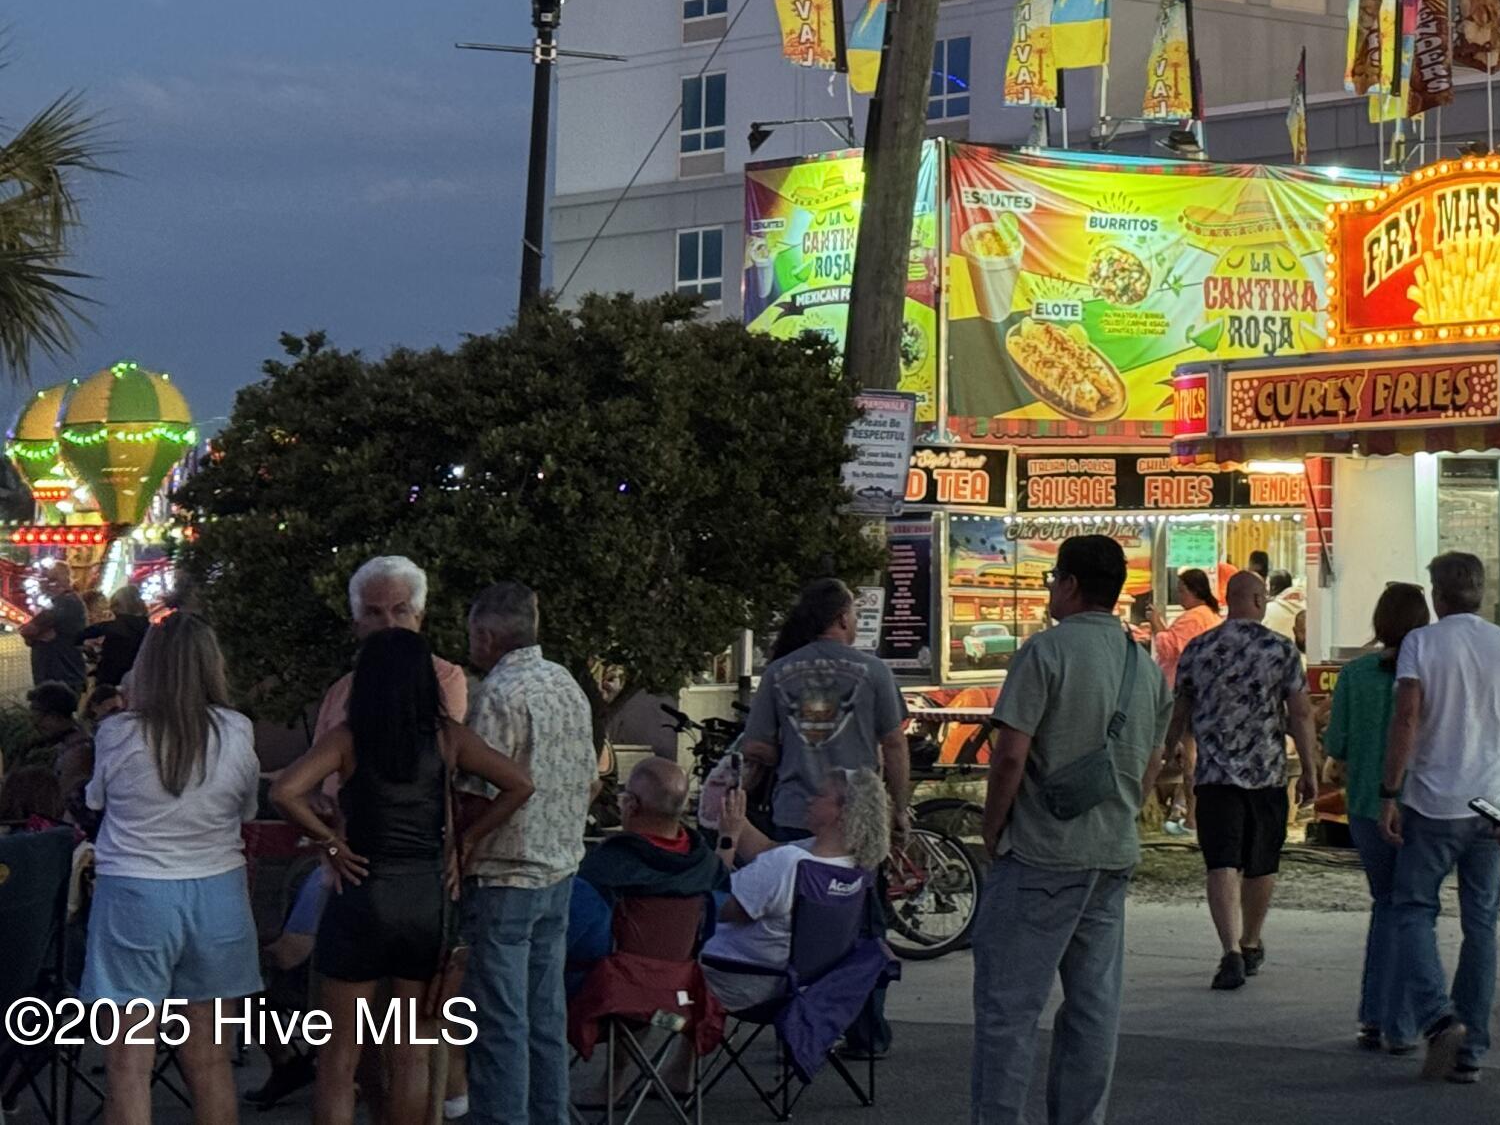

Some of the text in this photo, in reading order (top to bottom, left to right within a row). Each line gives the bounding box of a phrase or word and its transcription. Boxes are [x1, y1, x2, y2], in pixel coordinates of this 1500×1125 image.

[829, 212, 840, 225] LA
[1089, 216, 1159, 232] BURRITOS
[803, 228, 855, 255] CANTIN
[1363, 196, 1424, 296] FRY
[814, 253, 852, 280] ROSA
[1250, 252, 1272, 273] LA
[1203, 276, 1317, 312] CANTINA
[1035, 303, 1080, 317] ELOTE
[1228, 315, 1294, 355] ROSA
[1257, 368, 1471, 423] CURLY FRIES
[889, 419, 900, 428] Be
[1028, 458, 1116, 475] ITALIAN & POLISH
[933, 468, 990, 504] TEA
[1028, 476, 1116, 508] SAUSAGE
[1144, 475, 1213, 507] FRIES
